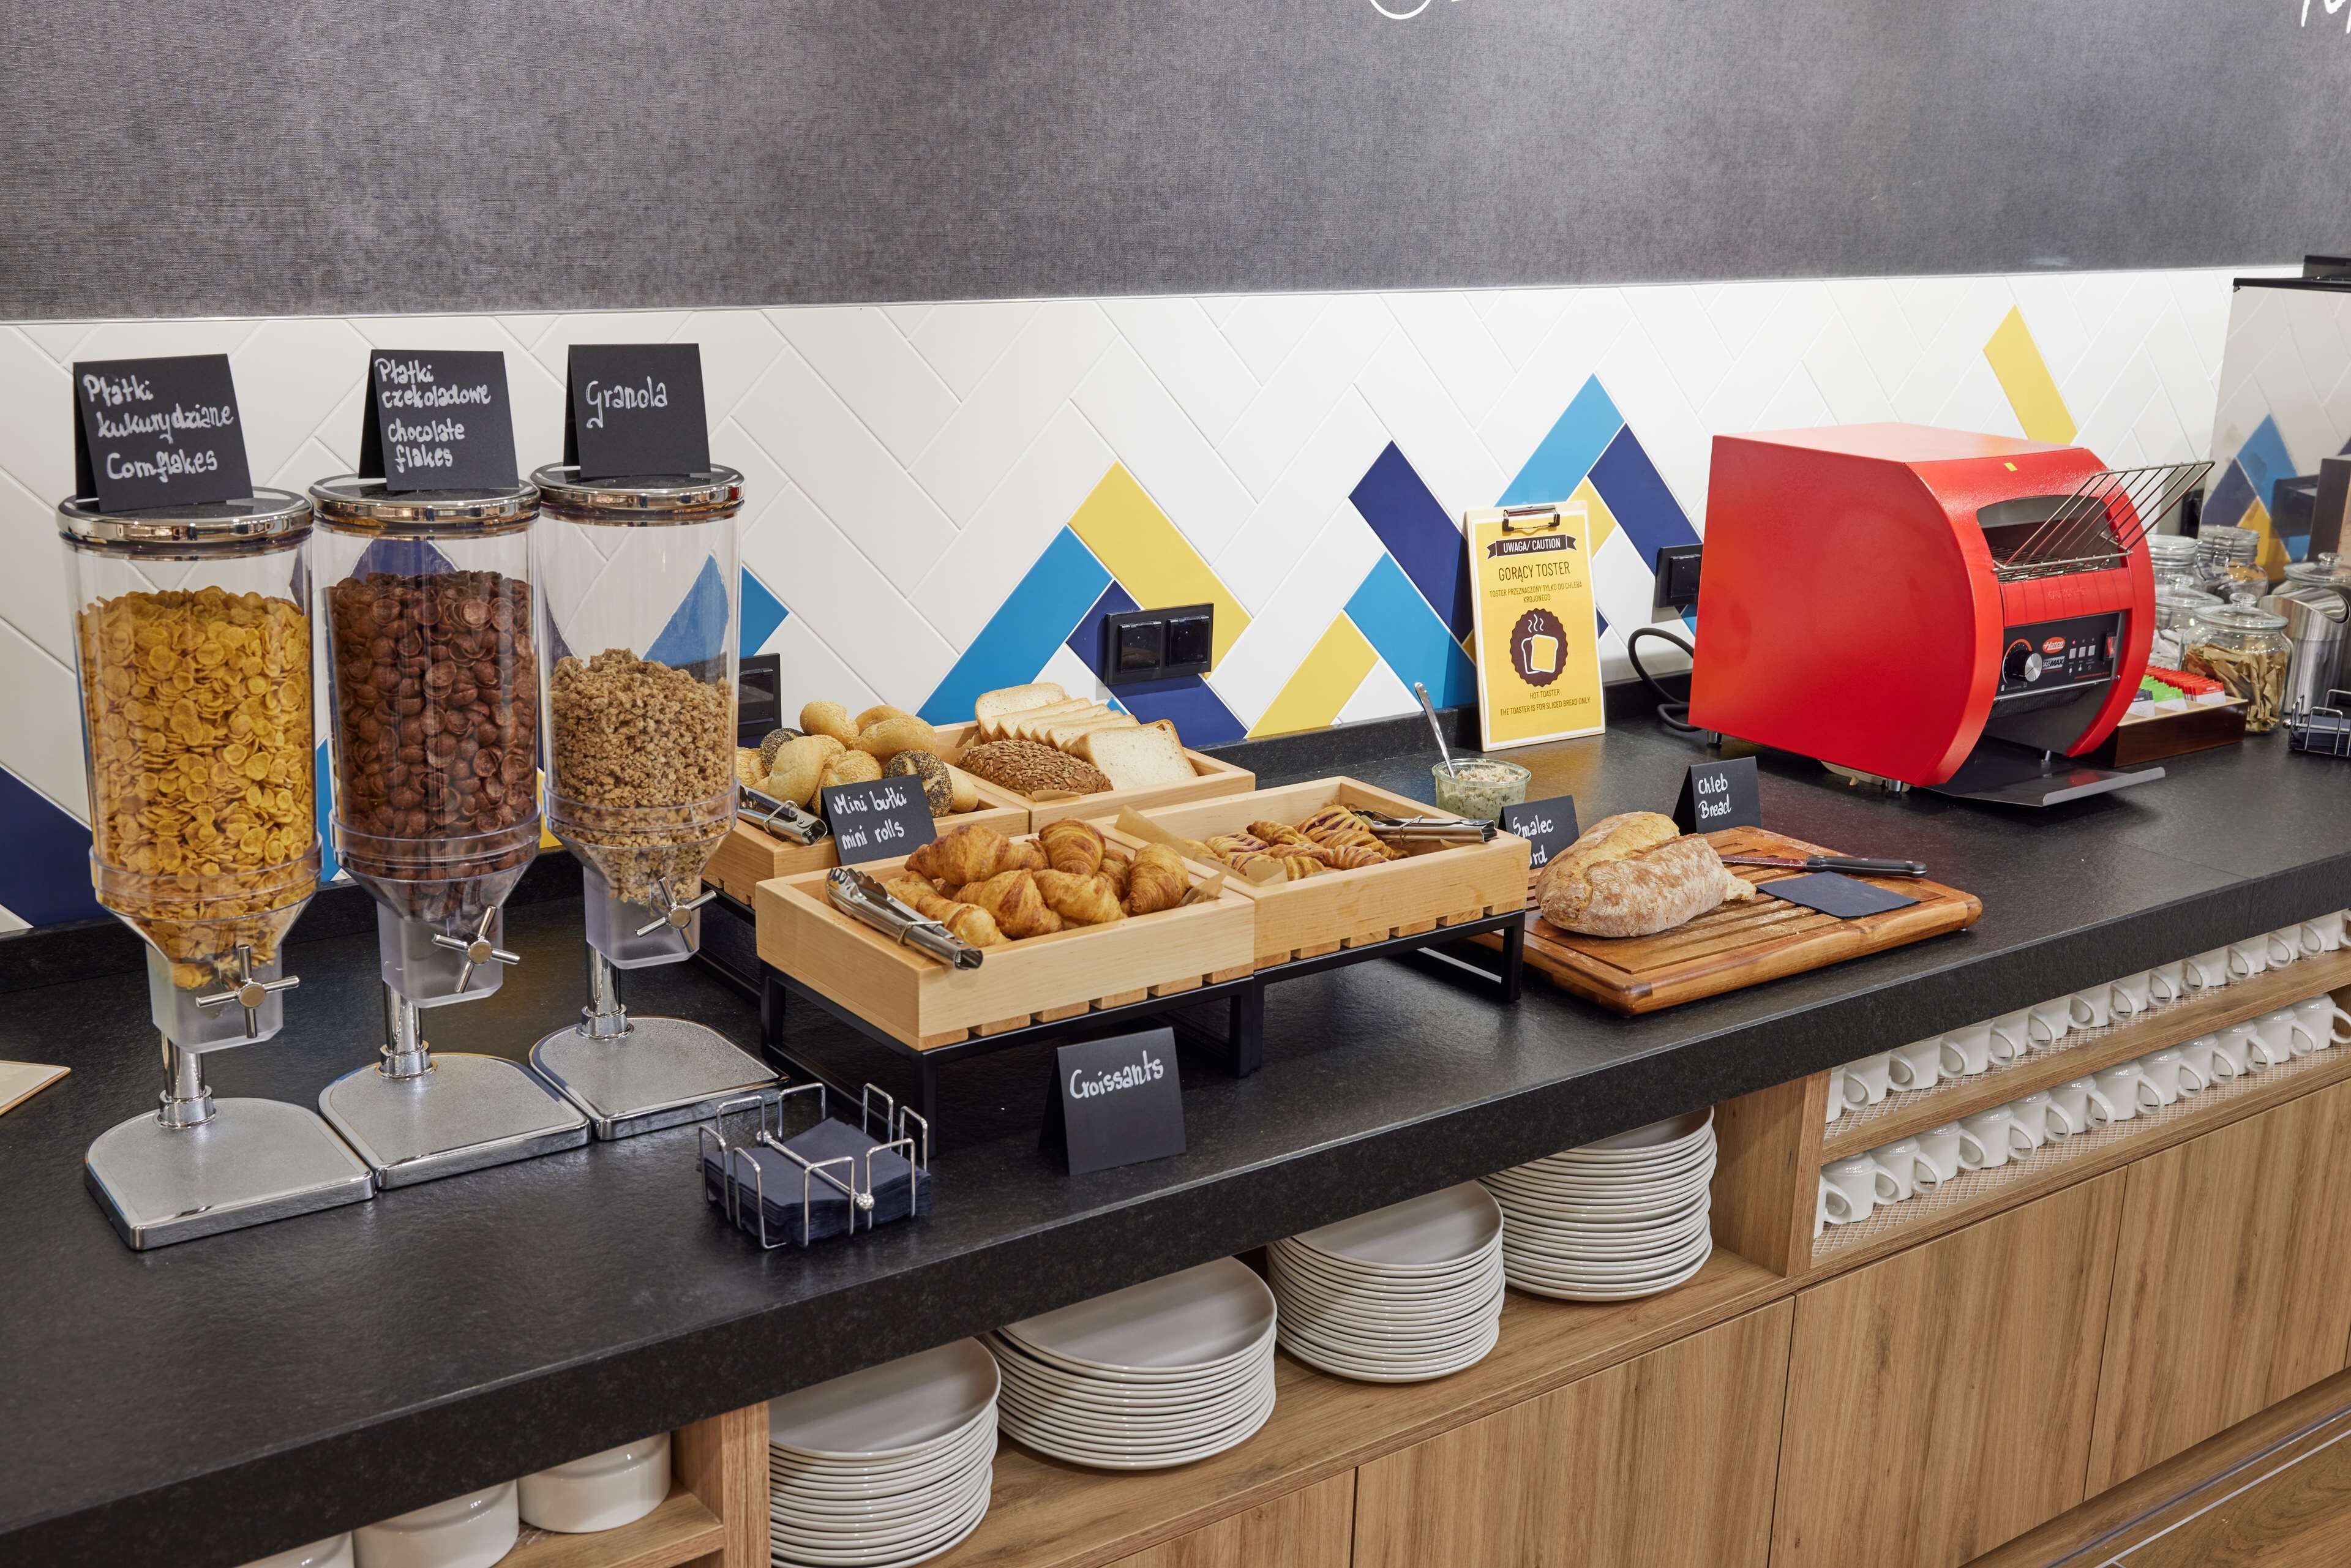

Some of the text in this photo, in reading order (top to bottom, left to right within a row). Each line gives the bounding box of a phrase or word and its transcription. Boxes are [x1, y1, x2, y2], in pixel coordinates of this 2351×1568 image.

[374, 358, 434, 384] Płatki
[83, 374, 154, 407] Płatki
[381, 384, 491, 408] czekoladowe
[96, 403, 234, 445] kukurydziane
[106, 449, 218, 483] Cornflakes
[395, 444, 453, 473] flakes
[1503, 538, 1561, 553] UWAGA/ CAUTION
[1498, 561, 1570, 582] GORĄCY TOSTER
[1507, 586, 1542, 596] PRZEZNACZONY
[1523, 594, 1551, 603] KROJONEGO
[1540, 688, 1560, 698] TOASTER
[1510, 706, 1530, 715] TOASTER
[1546, 700, 1562, 710] SLICED
[1563, 698, 1578, 707] BREAD
[1578, 696, 1591, 705] ONLY
[1698, 772, 1728, 795] Chleb
[833, 794, 868, 815] Mini
[1698, 793, 1732, 819] Bread
[841, 819, 905, 850] mini rolls
[1512, 814, 1554, 838] Smalec
[1069, 1050, 1164, 1099] Croissants
